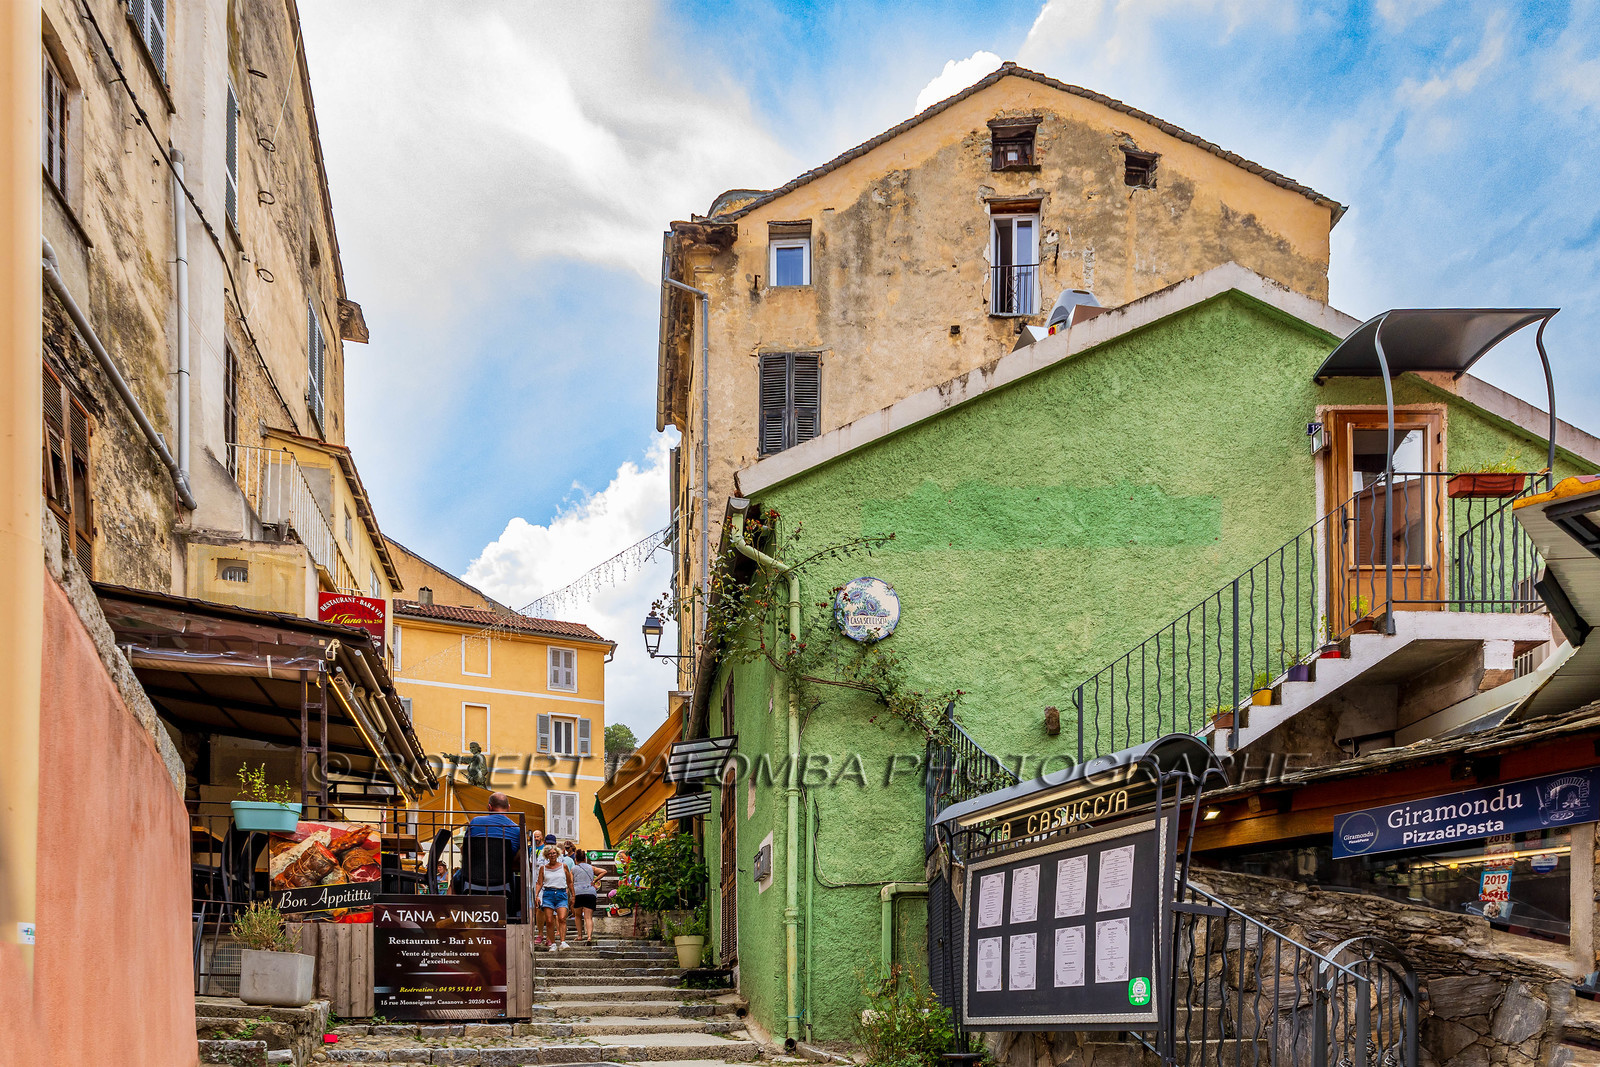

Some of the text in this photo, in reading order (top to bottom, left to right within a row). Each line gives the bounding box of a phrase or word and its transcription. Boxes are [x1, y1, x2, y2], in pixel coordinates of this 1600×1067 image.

[319, 597, 356, 612] RESTAURANT
[360, 599, 372, 609] BAR
[323, 614, 338, 624] A
[337, 613, 362, 625] Tana
[1387, 788, 1523, 829] Giramondu
[1001, 822, 1012, 841] A
[1402, 819, 1504, 844] Pizza&Pasta
[1484, 874, 1508, 885] 2019
[280, 887, 371, 909] Bon Appitittù
[381, 910, 392, 922] A
[397, 910, 435, 922] TANA
[450, 911, 499, 922] VIN250
[388, 936, 440, 945] Restaurant
[449, 937, 466, 945] Bar
[468, 937, 474, 945] à
[476, 937, 492, 945] Vin
